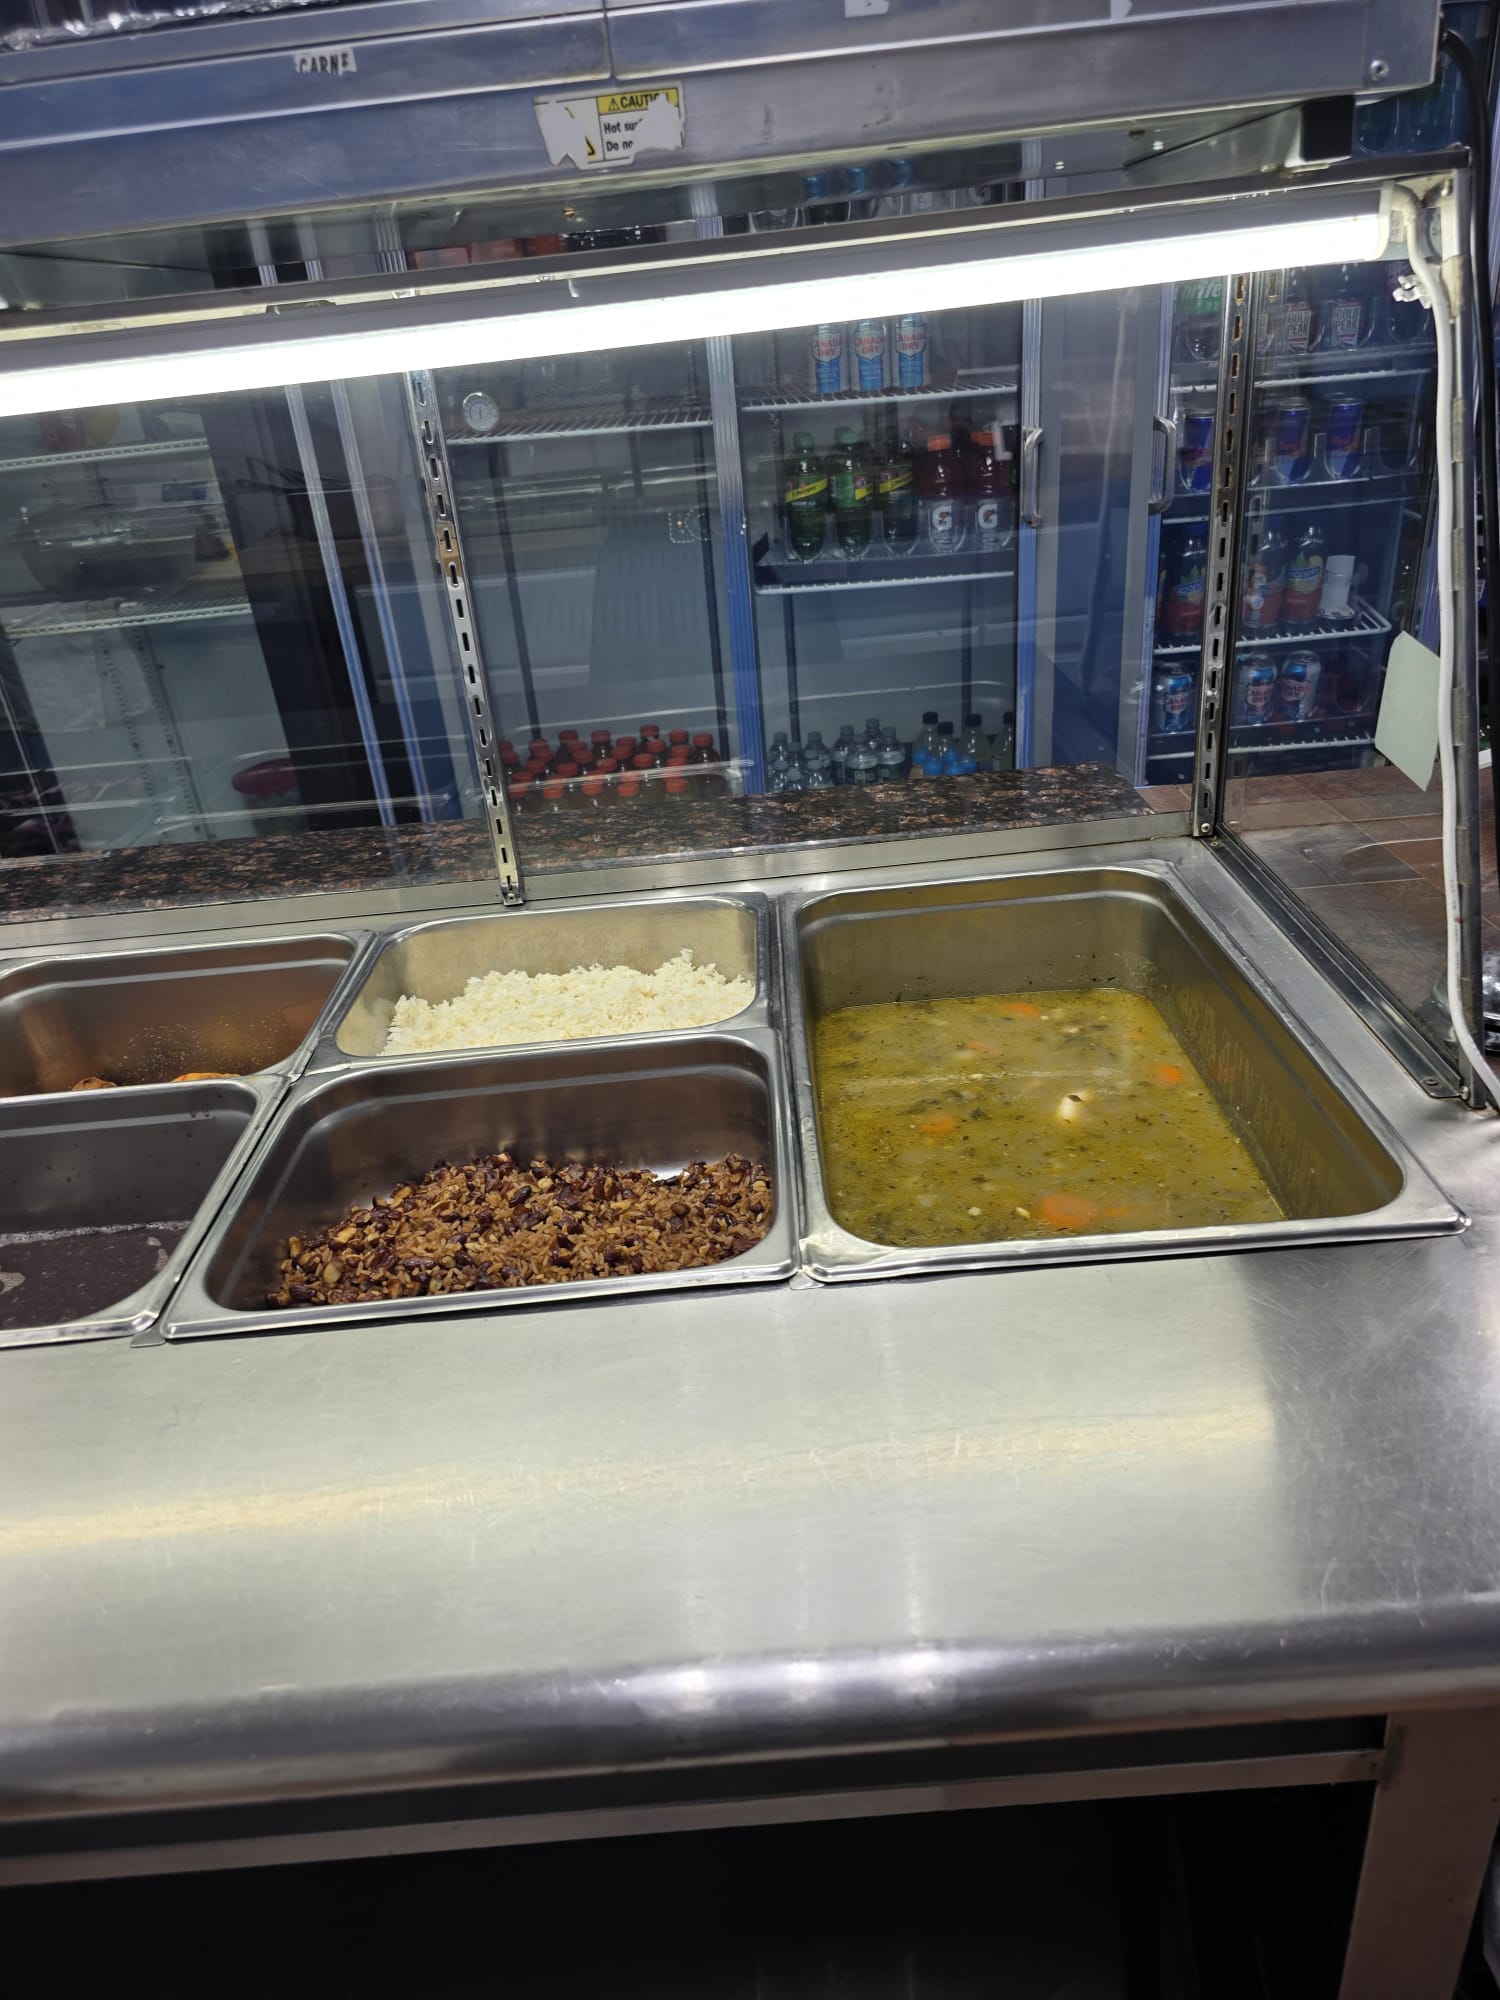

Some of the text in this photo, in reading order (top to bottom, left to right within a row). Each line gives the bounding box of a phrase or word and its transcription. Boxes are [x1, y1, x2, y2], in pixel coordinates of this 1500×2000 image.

[299, 52, 349, 75] CARNE
[603, 121, 621, 134] Hot
[606, 141, 619, 152] Do
[1335, 319, 1358, 333] PEAK
[817, 348, 836, 357] DRY
[862, 345, 879, 354] DRY
[901, 342, 919, 351] DRY
[932, 505, 952, 531] G
[978, 503, 998, 529] G
